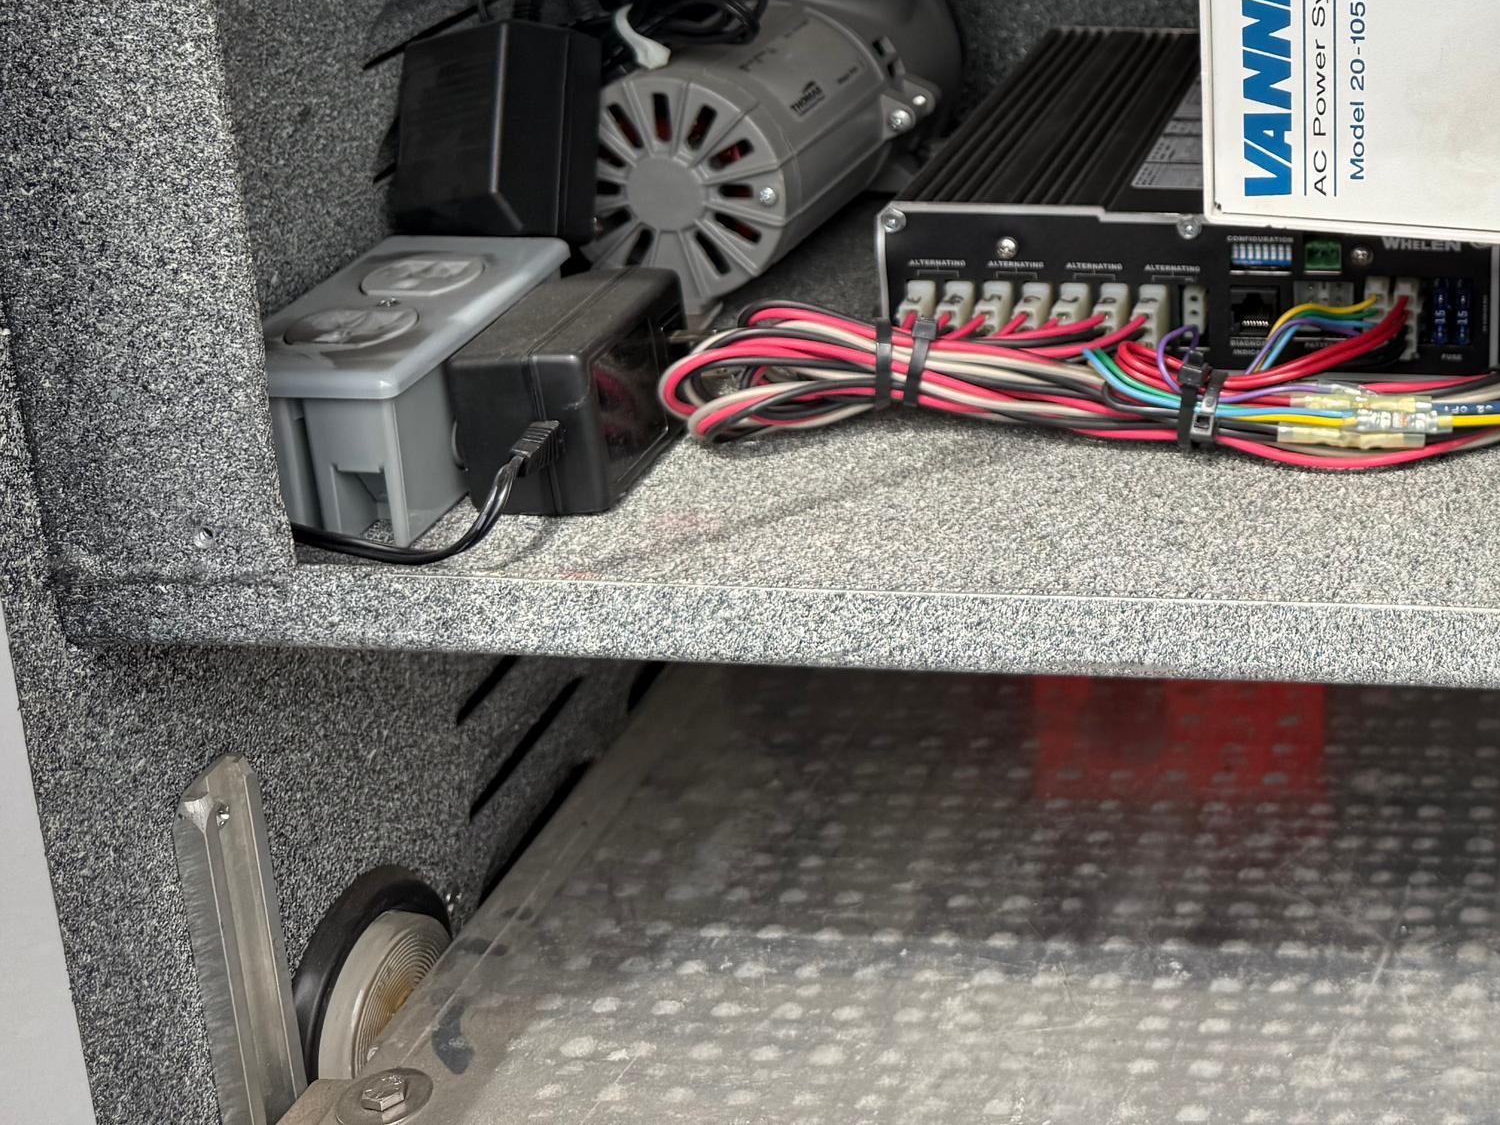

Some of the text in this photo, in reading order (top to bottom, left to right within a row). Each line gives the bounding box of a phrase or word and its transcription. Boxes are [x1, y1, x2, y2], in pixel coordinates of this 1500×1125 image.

[1314, 39, 1326, 136] Power
[1350, 102, 1365, 180] Model
[1314, 151, 1327, 196] AC
[1382, 237, 1461, 252] WHELEN
[1066, 262, 1123, 270] ALTERNATING
[1144, 264, 1200, 272] ALTERNATING
[1434, 310, 1446, 324] 15
[1457, 310, 1468, 325] 15
